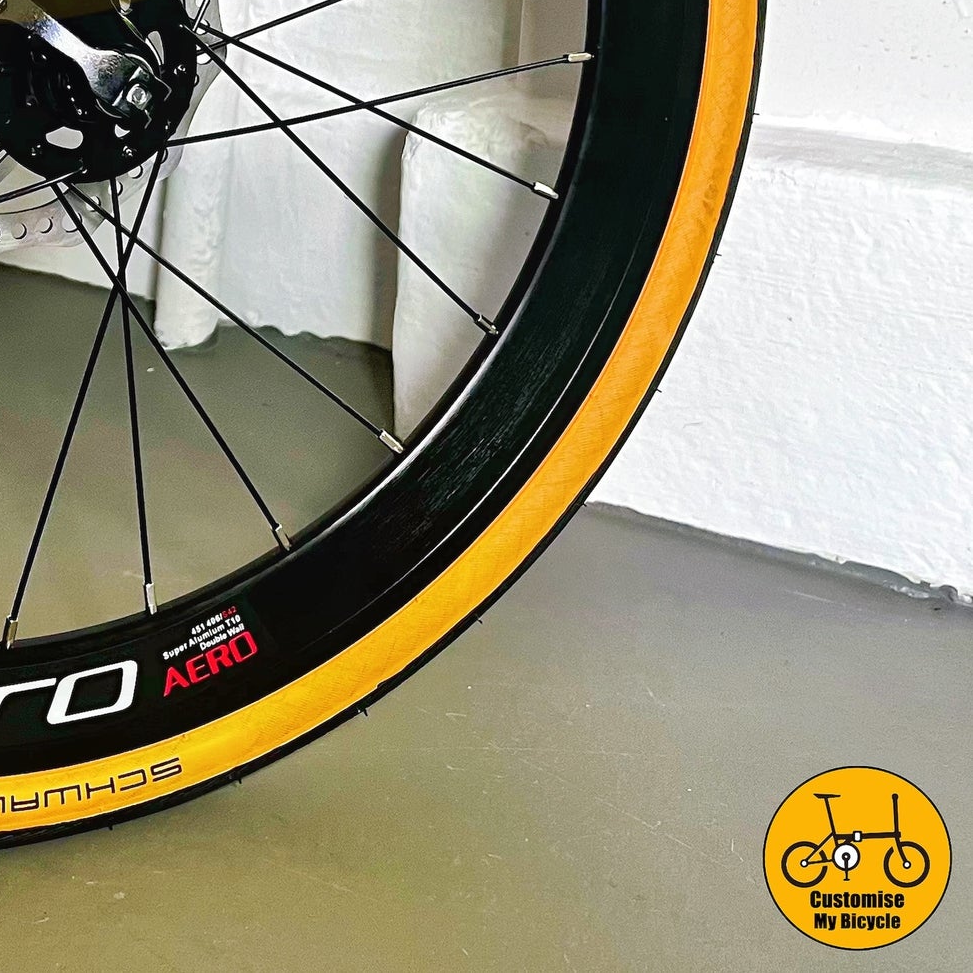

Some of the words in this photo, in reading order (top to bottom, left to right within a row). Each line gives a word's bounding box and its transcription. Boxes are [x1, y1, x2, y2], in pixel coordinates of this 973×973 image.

[162, 642, 188, 660] Super
[225, 614, 241, 627] T10
[191, 623, 206, 635] 451
[199, 632, 228, 651] Double
[227, 623, 245, 636] Wall
[163, 631, 258, 697] AERO
